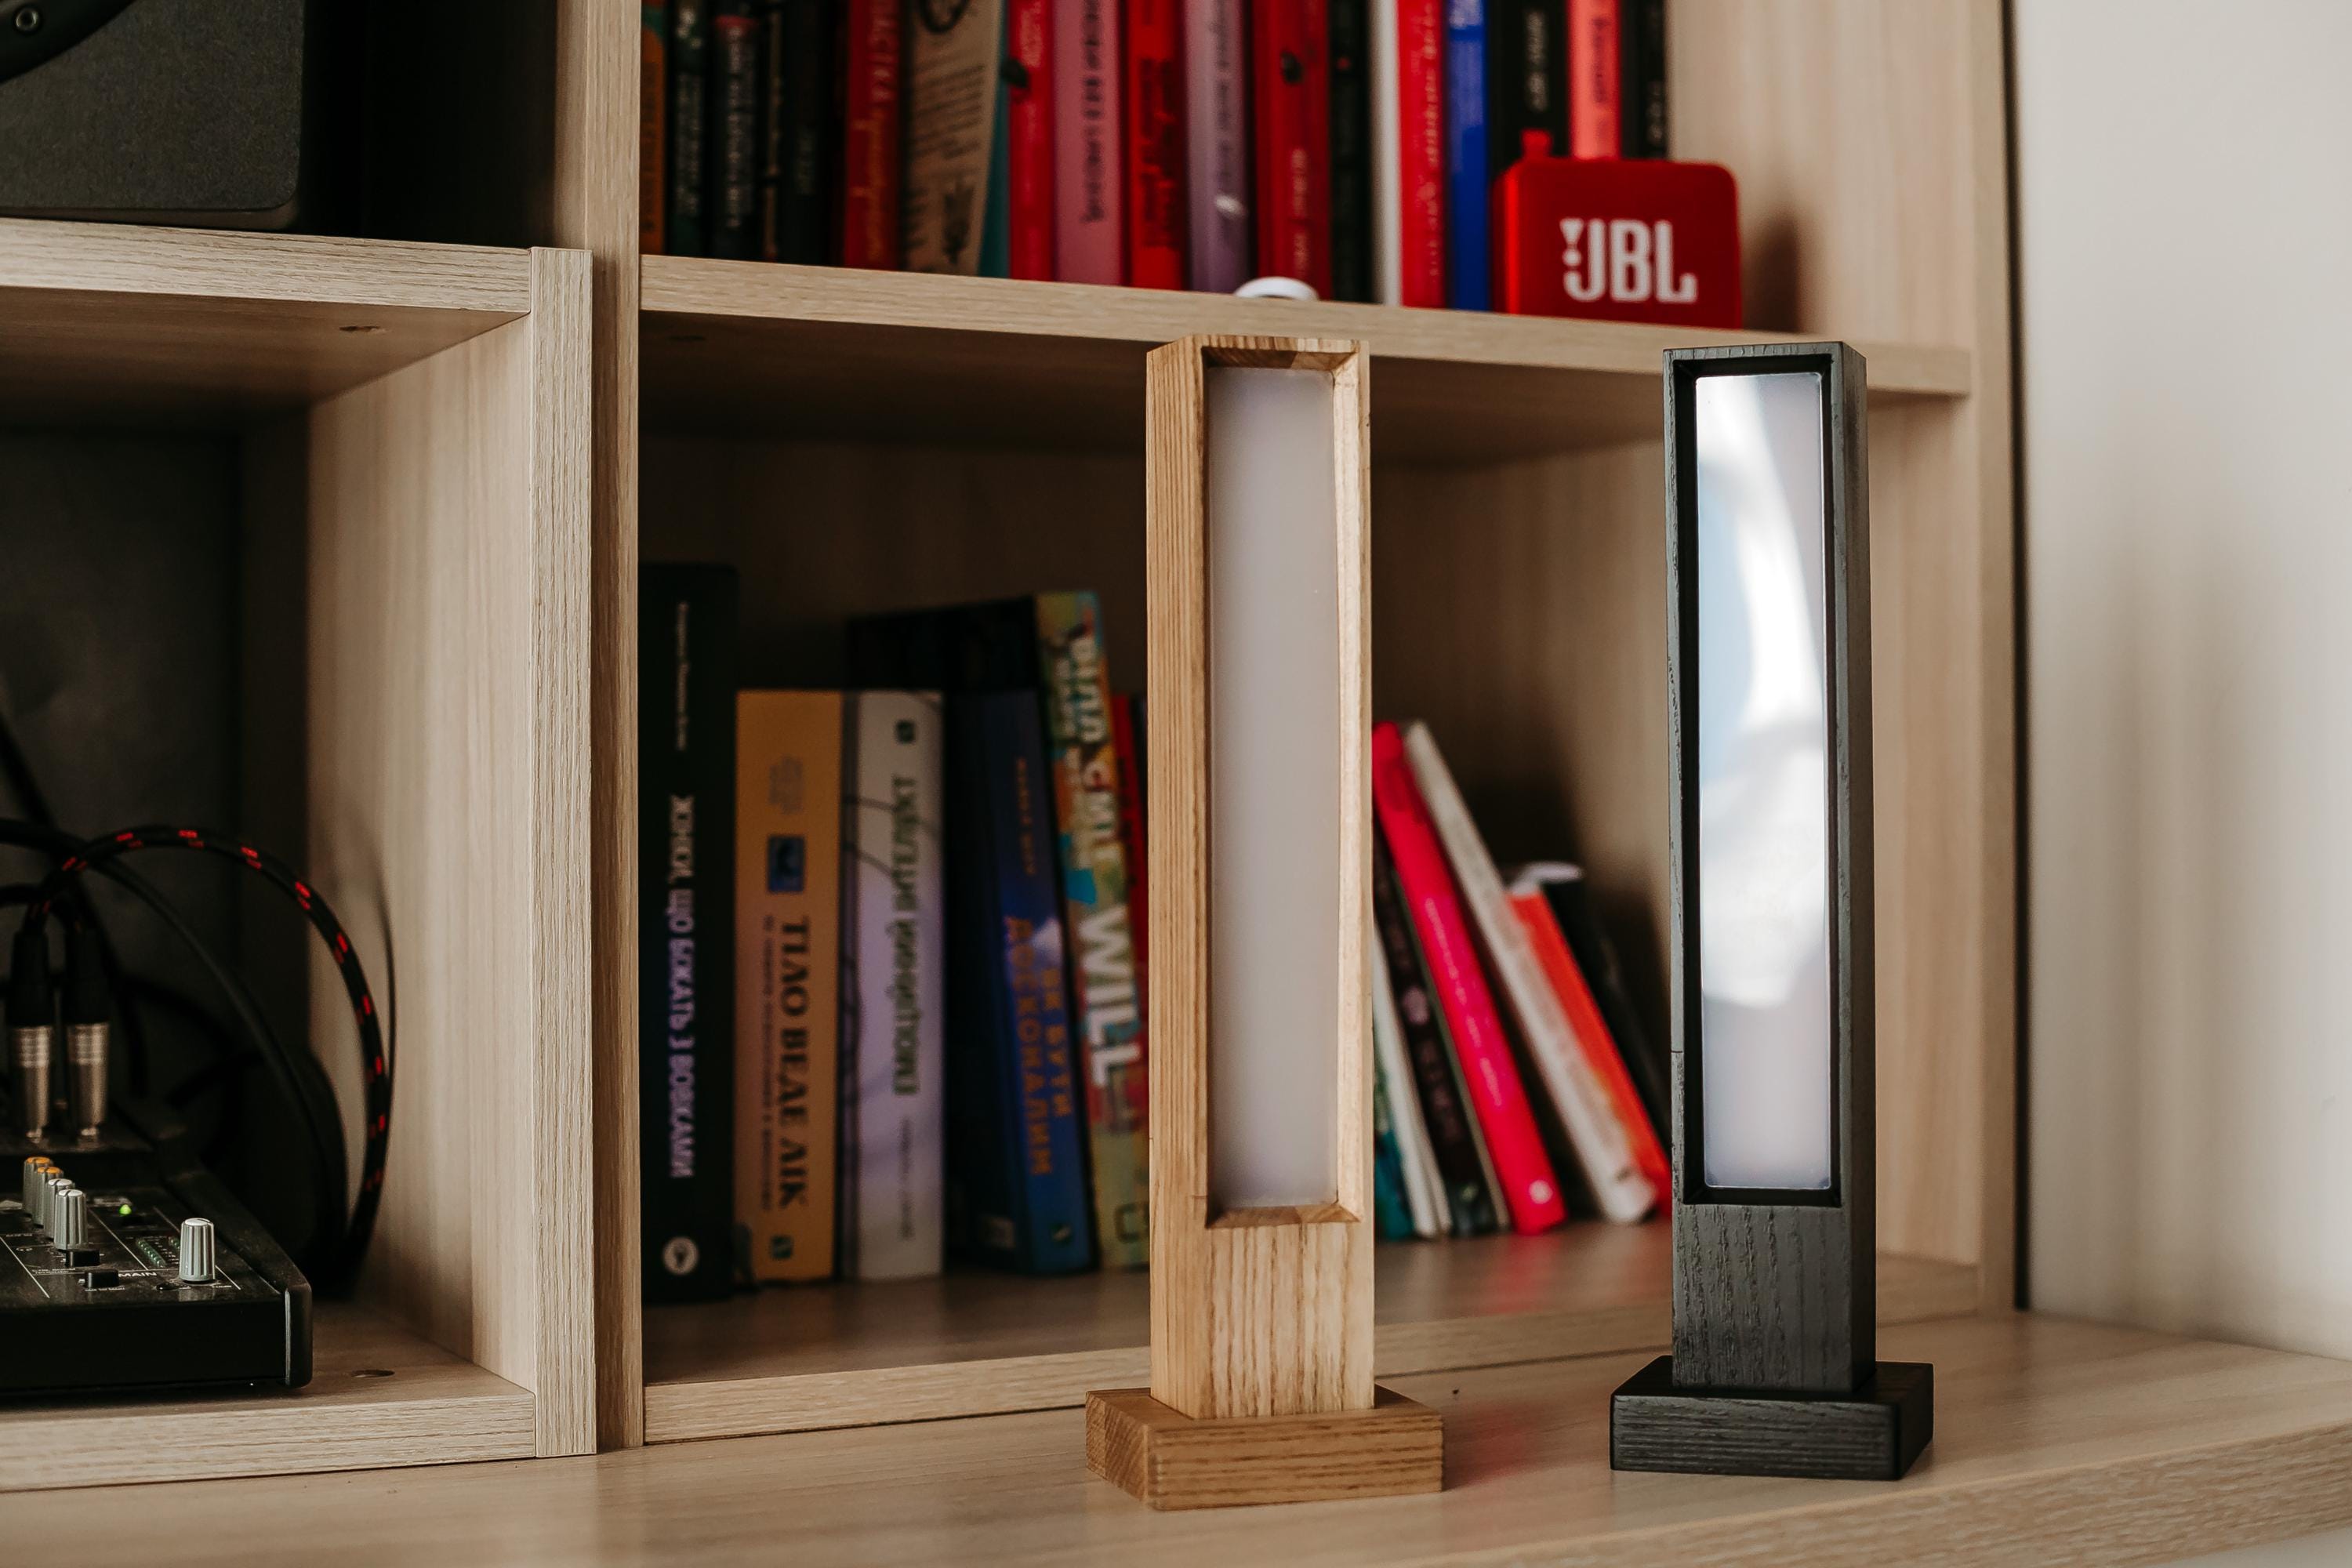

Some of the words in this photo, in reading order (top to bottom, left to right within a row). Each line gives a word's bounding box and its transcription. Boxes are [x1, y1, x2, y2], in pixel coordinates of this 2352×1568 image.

[1559, 218, 1697, 304] JBL
[781, 916, 811, 1016] ТІЛО
[1077, 904, 1142, 1087] WILL
